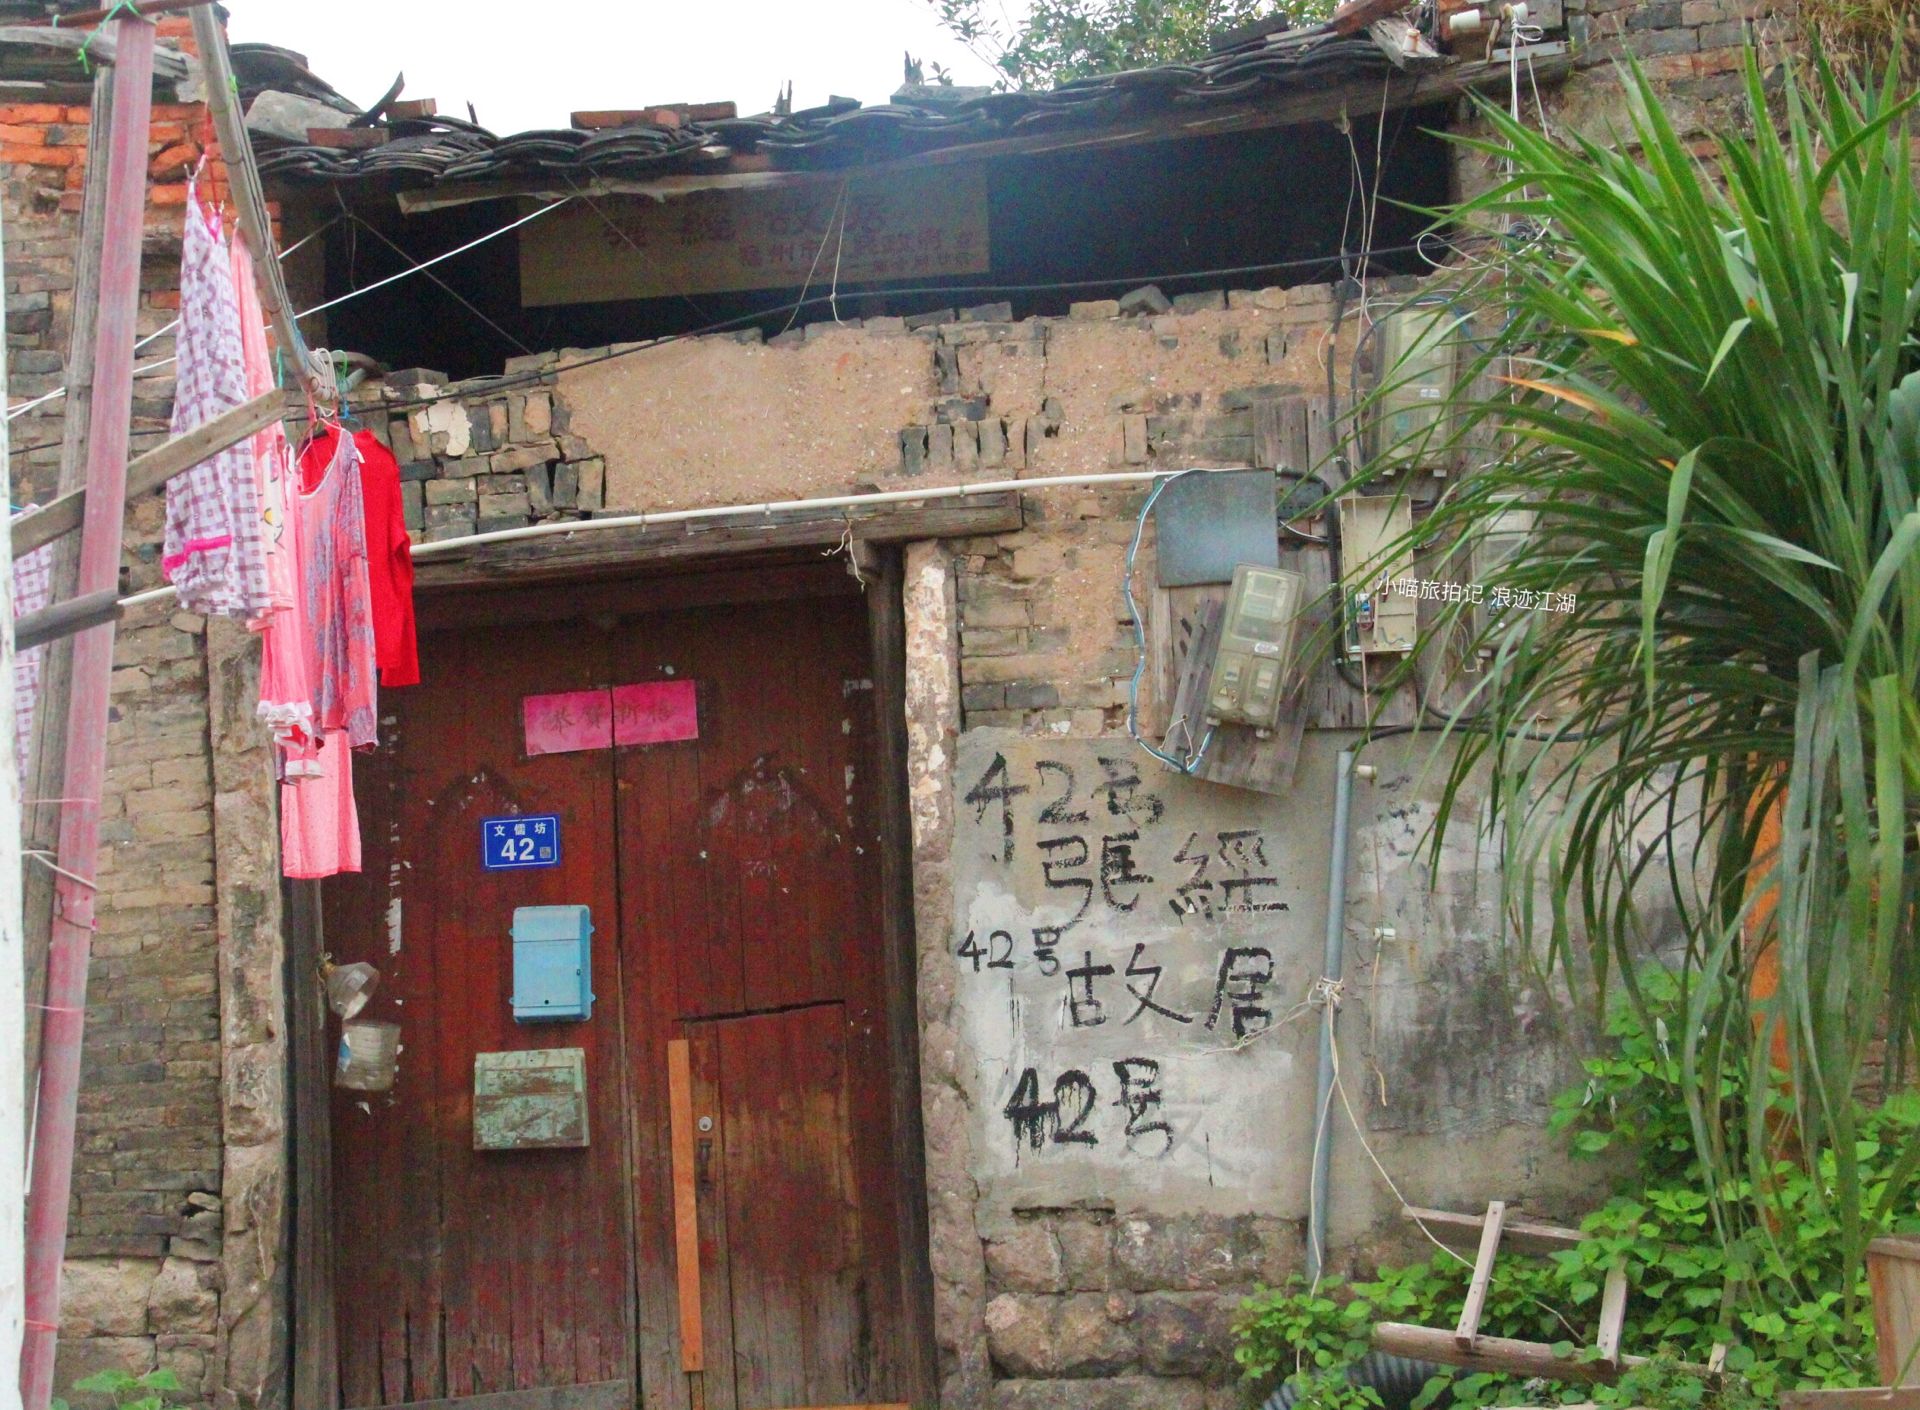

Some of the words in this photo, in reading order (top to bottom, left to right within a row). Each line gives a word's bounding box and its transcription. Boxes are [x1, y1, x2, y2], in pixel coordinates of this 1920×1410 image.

[493, 822, 546, 837] 文儒坊
[501, 838, 535, 861] 42
[1065, 943, 1274, 1039] 故居
